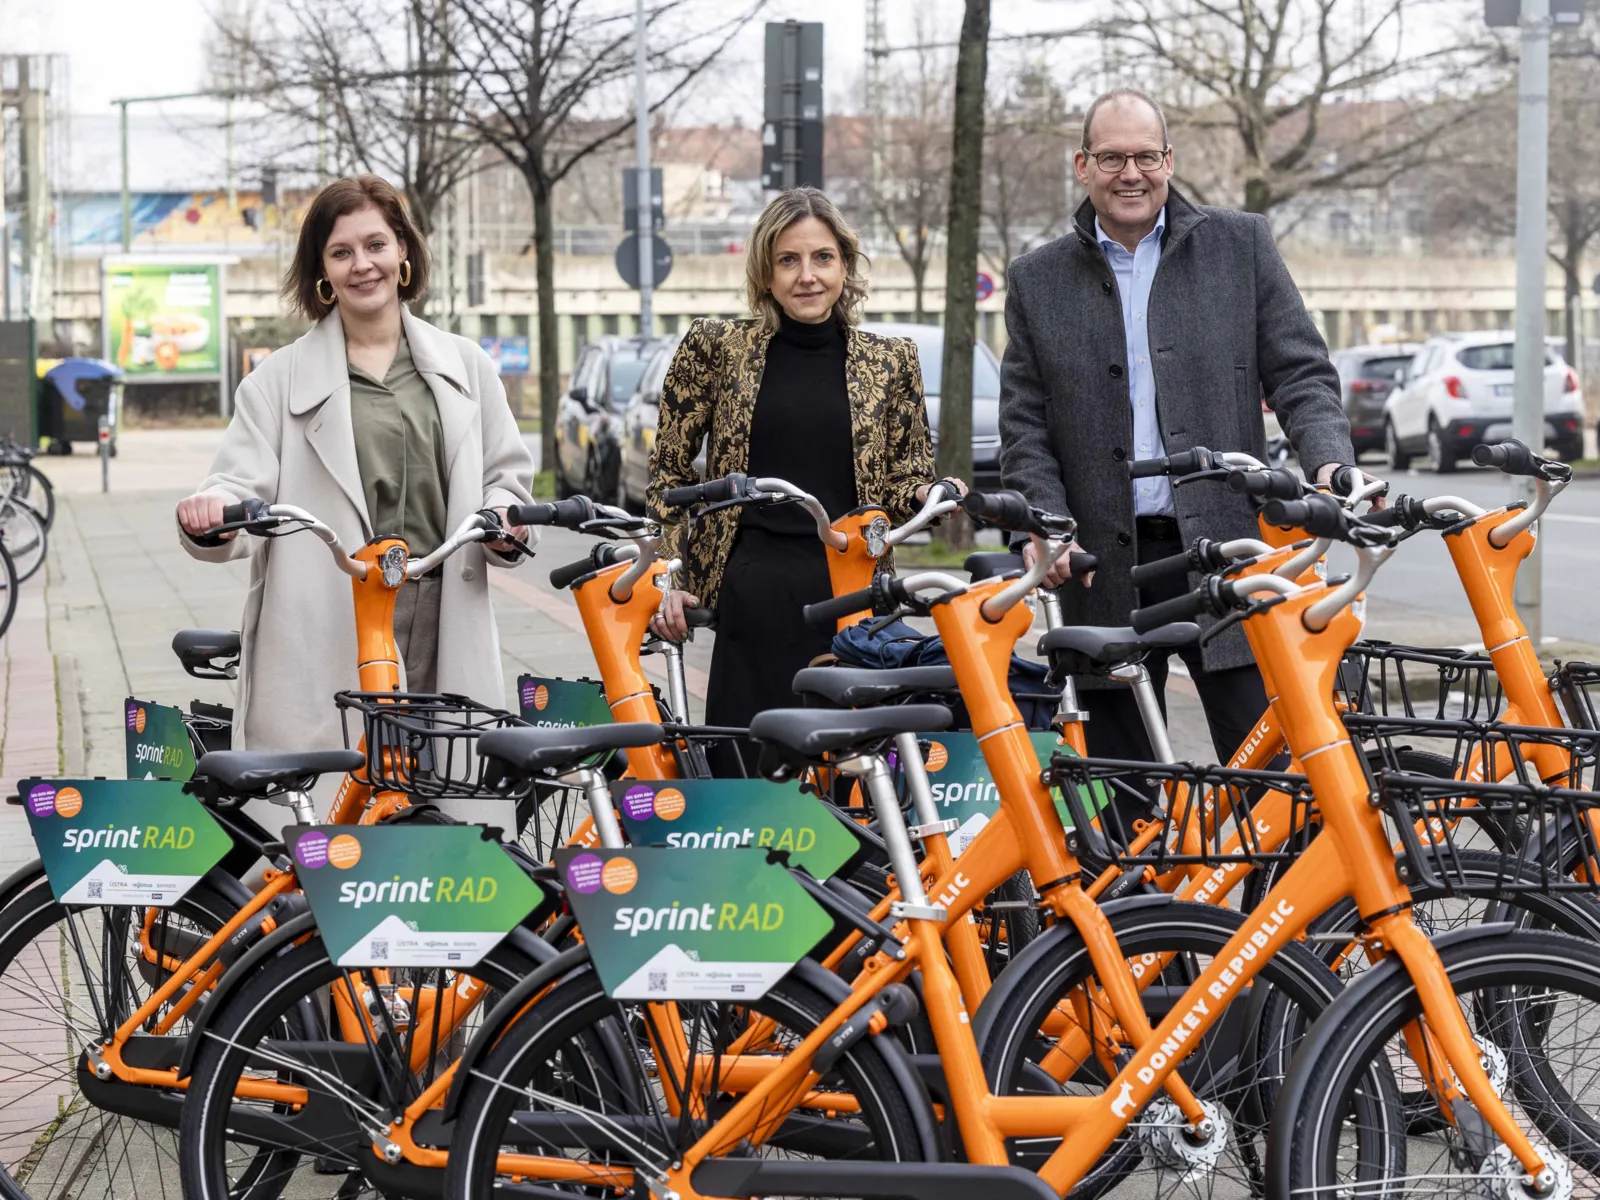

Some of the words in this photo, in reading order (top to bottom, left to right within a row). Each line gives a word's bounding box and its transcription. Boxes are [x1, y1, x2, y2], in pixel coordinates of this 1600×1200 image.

[1231, 721, 1270, 769] PUBLIC
[1137, 998, 1210, 1085] DONKEY
[1208, 899, 1295, 1000] REPUBLIC
